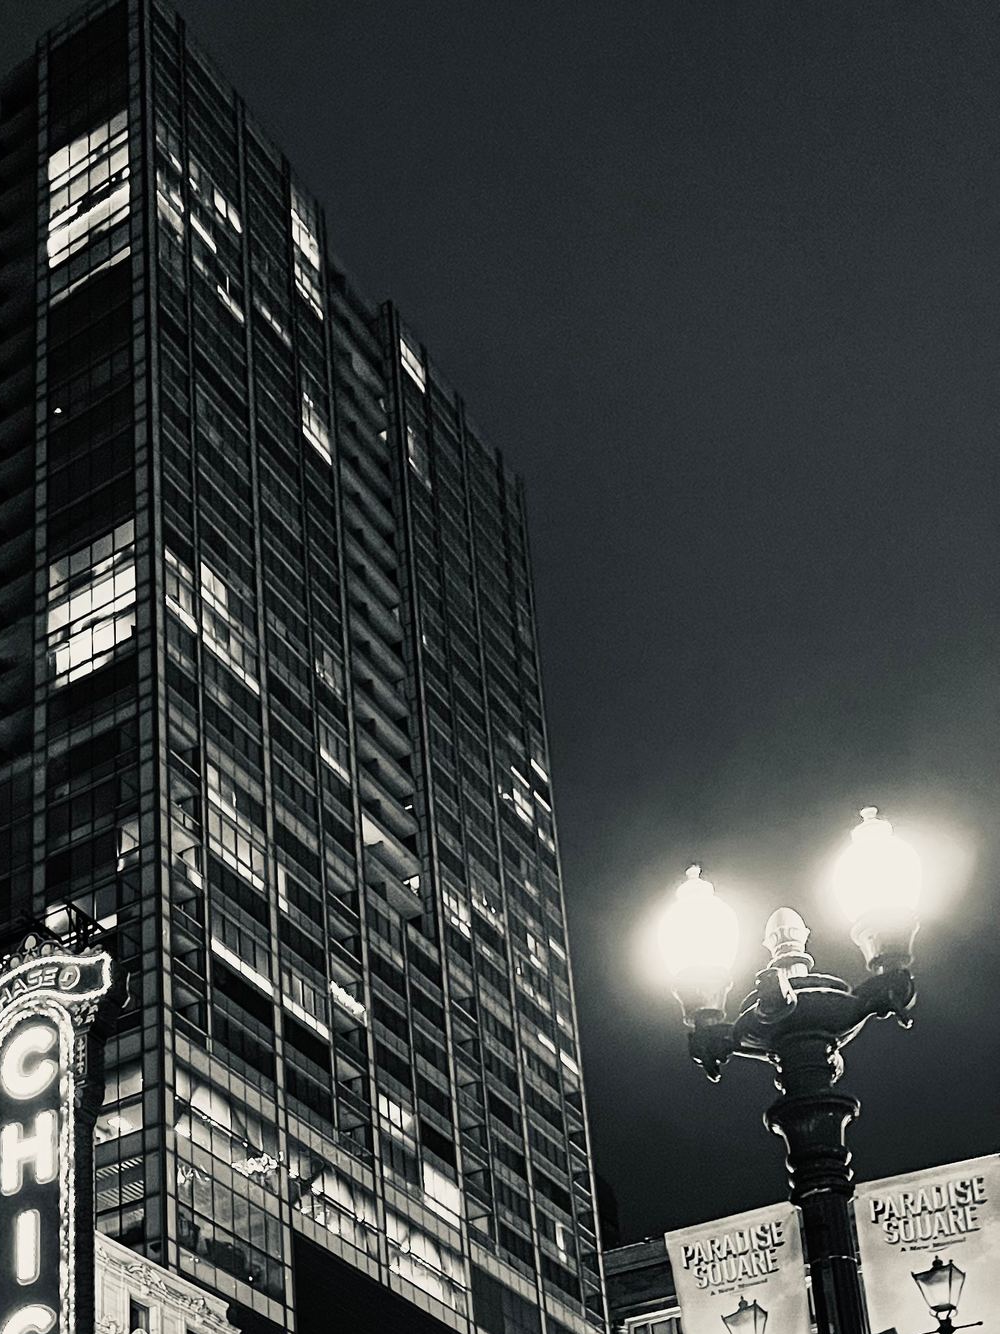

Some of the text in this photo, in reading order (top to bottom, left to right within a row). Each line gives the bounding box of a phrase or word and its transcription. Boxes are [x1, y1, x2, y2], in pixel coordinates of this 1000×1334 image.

[869, 1176, 988, 1224] PARADISE
[681, 1221, 787, 1269] PARADISE
[882, 1206, 981, 1244] SQUARE
[693, 1248, 780, 1289] SQUARE
